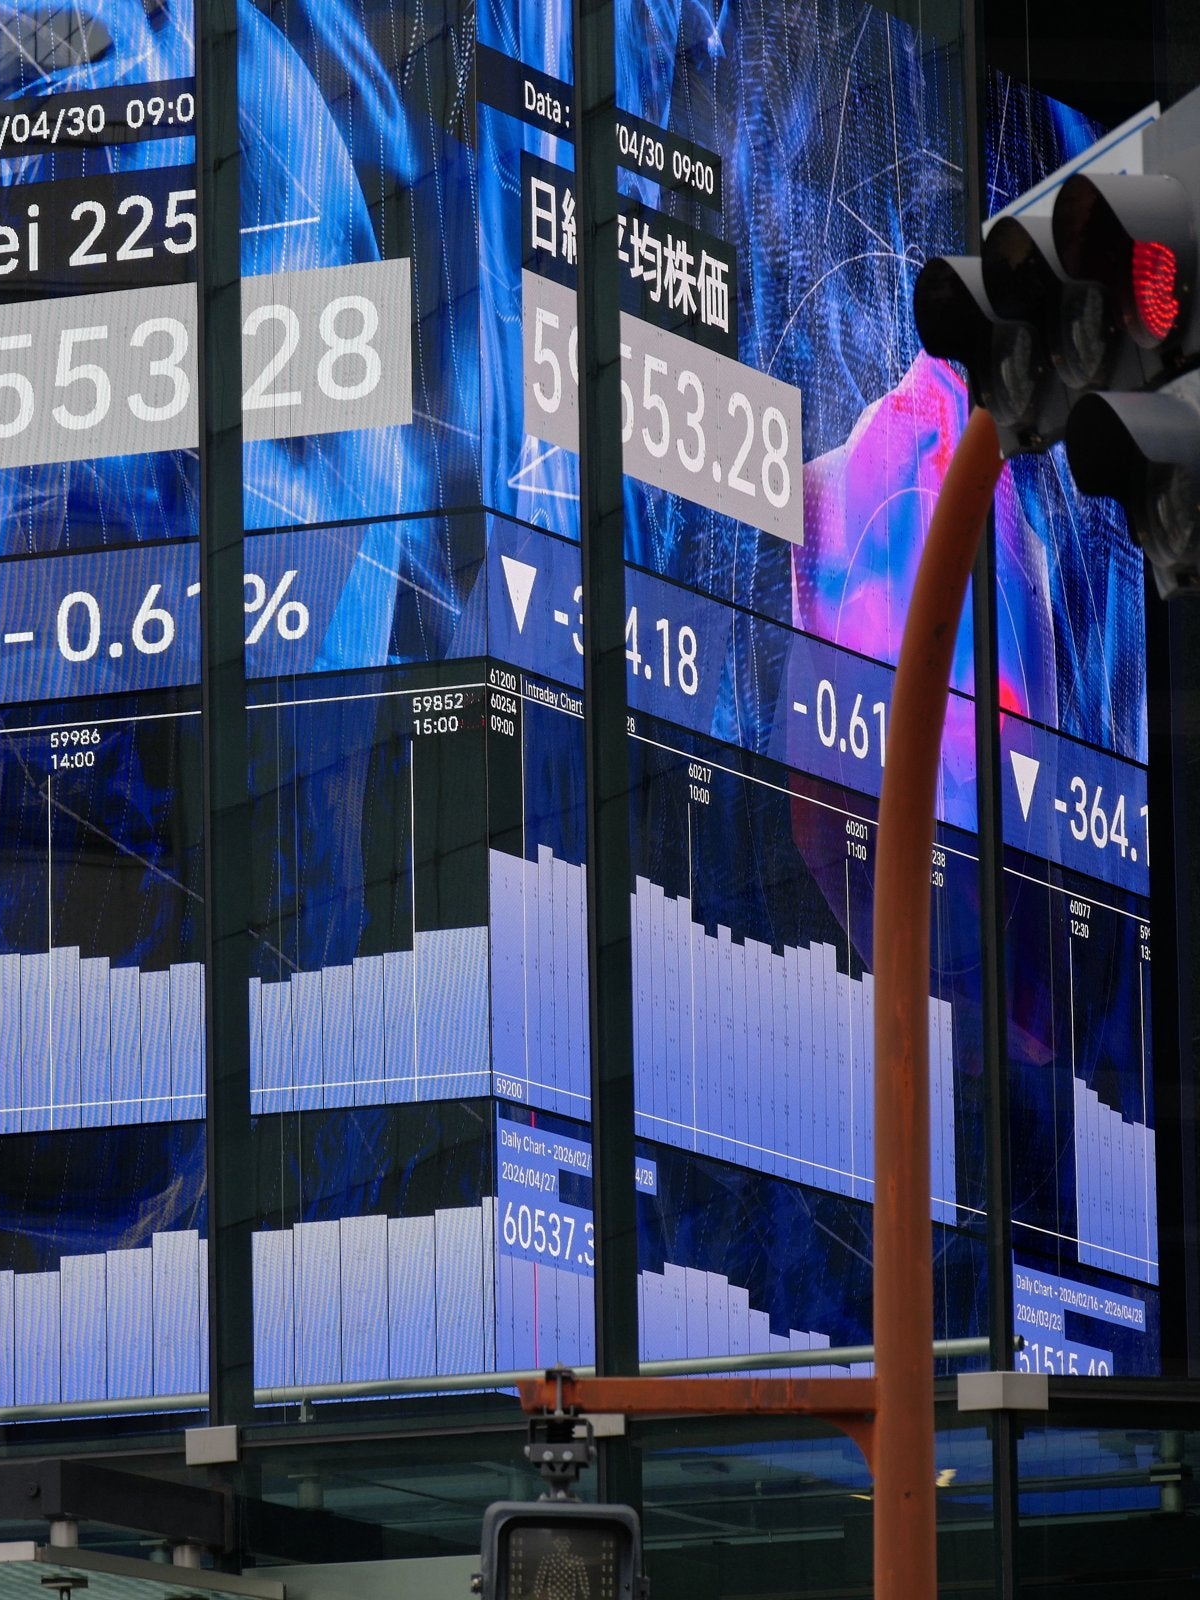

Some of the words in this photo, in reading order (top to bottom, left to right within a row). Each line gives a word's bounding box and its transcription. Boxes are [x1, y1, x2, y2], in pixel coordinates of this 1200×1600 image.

[126, 92, 195, 130] 09:0
[672, 150, 714, 195] 09:00
[68, 189, 197, 268] 225
[553, 585, 699, 696] -34.18
[489, 667, 517, 691] 61200
[412, 692, 464, 714] 59852
[490, 692, 517, 716] 60254
[525, 679, 559, 708] Intraday
[560, 692, 584, 715] Chart
[413, 715, 460, 736] 15:00
[490, 714, 515, 737] 09:00
[793, 679, 886, 768] -0.61
[50, 728, 101, 748] 59986
[50, 750, 95, 770] 14:00
[688, 762, 712, 784] 60217
[689, 783, 711, 805] 10:00
[845, 819, 869, 841] 60201
[846, 841, 867, 861] 11:00
[1069, 899, 1091, 919] 60077
[1070, 919, 1090, 939] 12:30
[496, 1077, 523, 1100] 59200
[501, 1130, 522, 1154] Daily
[523, 1135, 546, 1157] Chart
[502, 1161, 556, 1192] 2026/04/27
[1016, 1274, 1033, 1296] Daily
[1033, 1279, 1053, 1299] Chart
[1059, 1286, 1099, 1311] 2026/02/16
[1104, 1299, 1144, 1324] 2026/04/28
[1016, 1303, 1063, 1332] 2026/03/23
